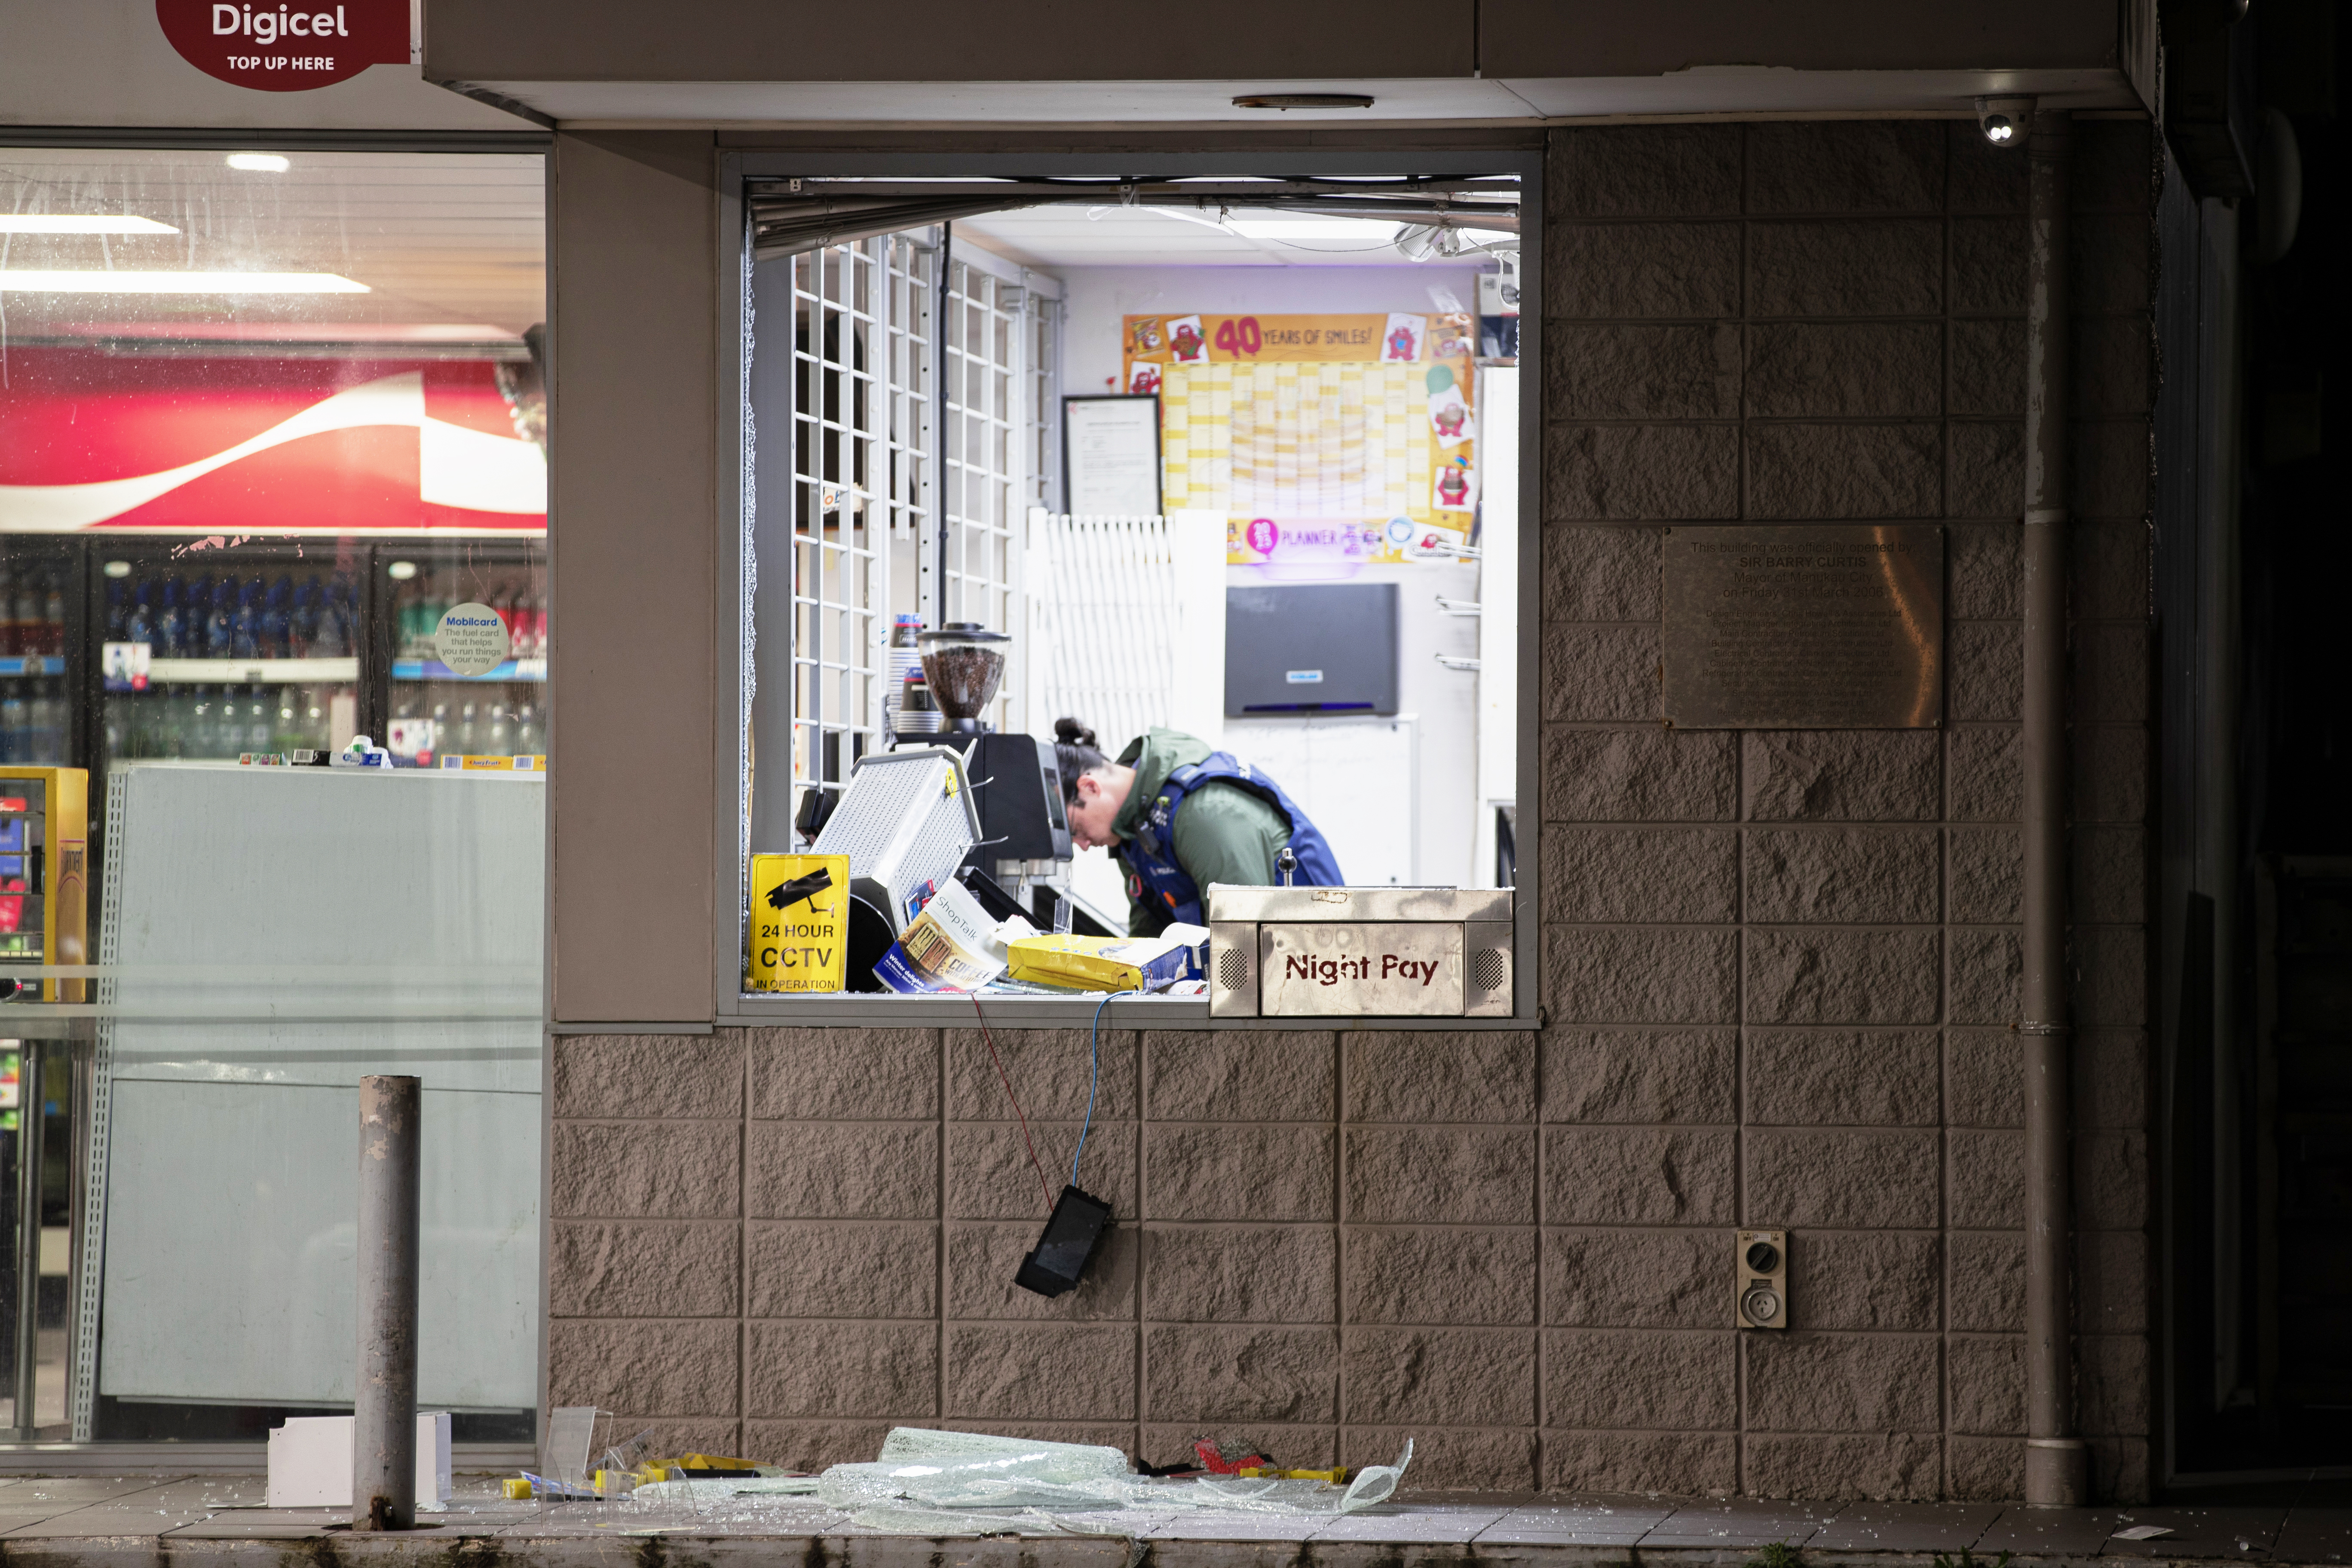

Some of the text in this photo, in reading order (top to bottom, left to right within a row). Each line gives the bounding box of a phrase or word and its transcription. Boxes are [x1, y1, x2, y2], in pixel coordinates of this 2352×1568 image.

[213, 4, 348, 44] Digicel
[227, 56, 334, 70] TOP UP HERE
[1215, 316, 1373, 359] 40 YEARS OF SMILES!
[1282, 530, 1337, 545] PLANNER
[1691, 542, 1716, 553] This
[1720, 542, 1766, 554] building
[1798, 542, 1845, 554] officially
[1849, 542, 1894, 554] opened
[1740, 556, 1866, 567] SIR BARRY CURTIS
[1734, 572, 1872, 585] Mayor of Manukau City
[1743, 587, 1779, 600] Friday
[1783, 587, 1808, 597] 31st
[1813, 587, 1849, 597] March
[1853, 587, 1883, 597] 2006
[1706, 609, 1734, 619] Design
[446, 617, 497, 626] Mobilcard
[1713, 620, 1740, 628] Project
[1783, 620, 1825, 628] Integrating
[470, 638, 492, 647] helps
[1712, 640, 1743, 649] Building
[475, 648, 501, 656] things
[1710, 660, 1748, 668] Cabinetry
[1721, 680, 1755, 689] Security
[1733, 689, 1765, 698] Signage
[1834, 689, 1856, 698] Signs
[762, 924, 834, 937] 24 HOUR
[761, 947, 833, 968] CCTV
[889, 953, 906, 972] Winter
[904, 970, 925, 988] delights
[891, 963, 902, 977] Monster
[946, 968, 960, 979] WITH
[949, 959, 993, 980] COFFEE
[1286, 954, 1439, 986] Night Pay
[756, 980, 835, 989] IN OPERATION
